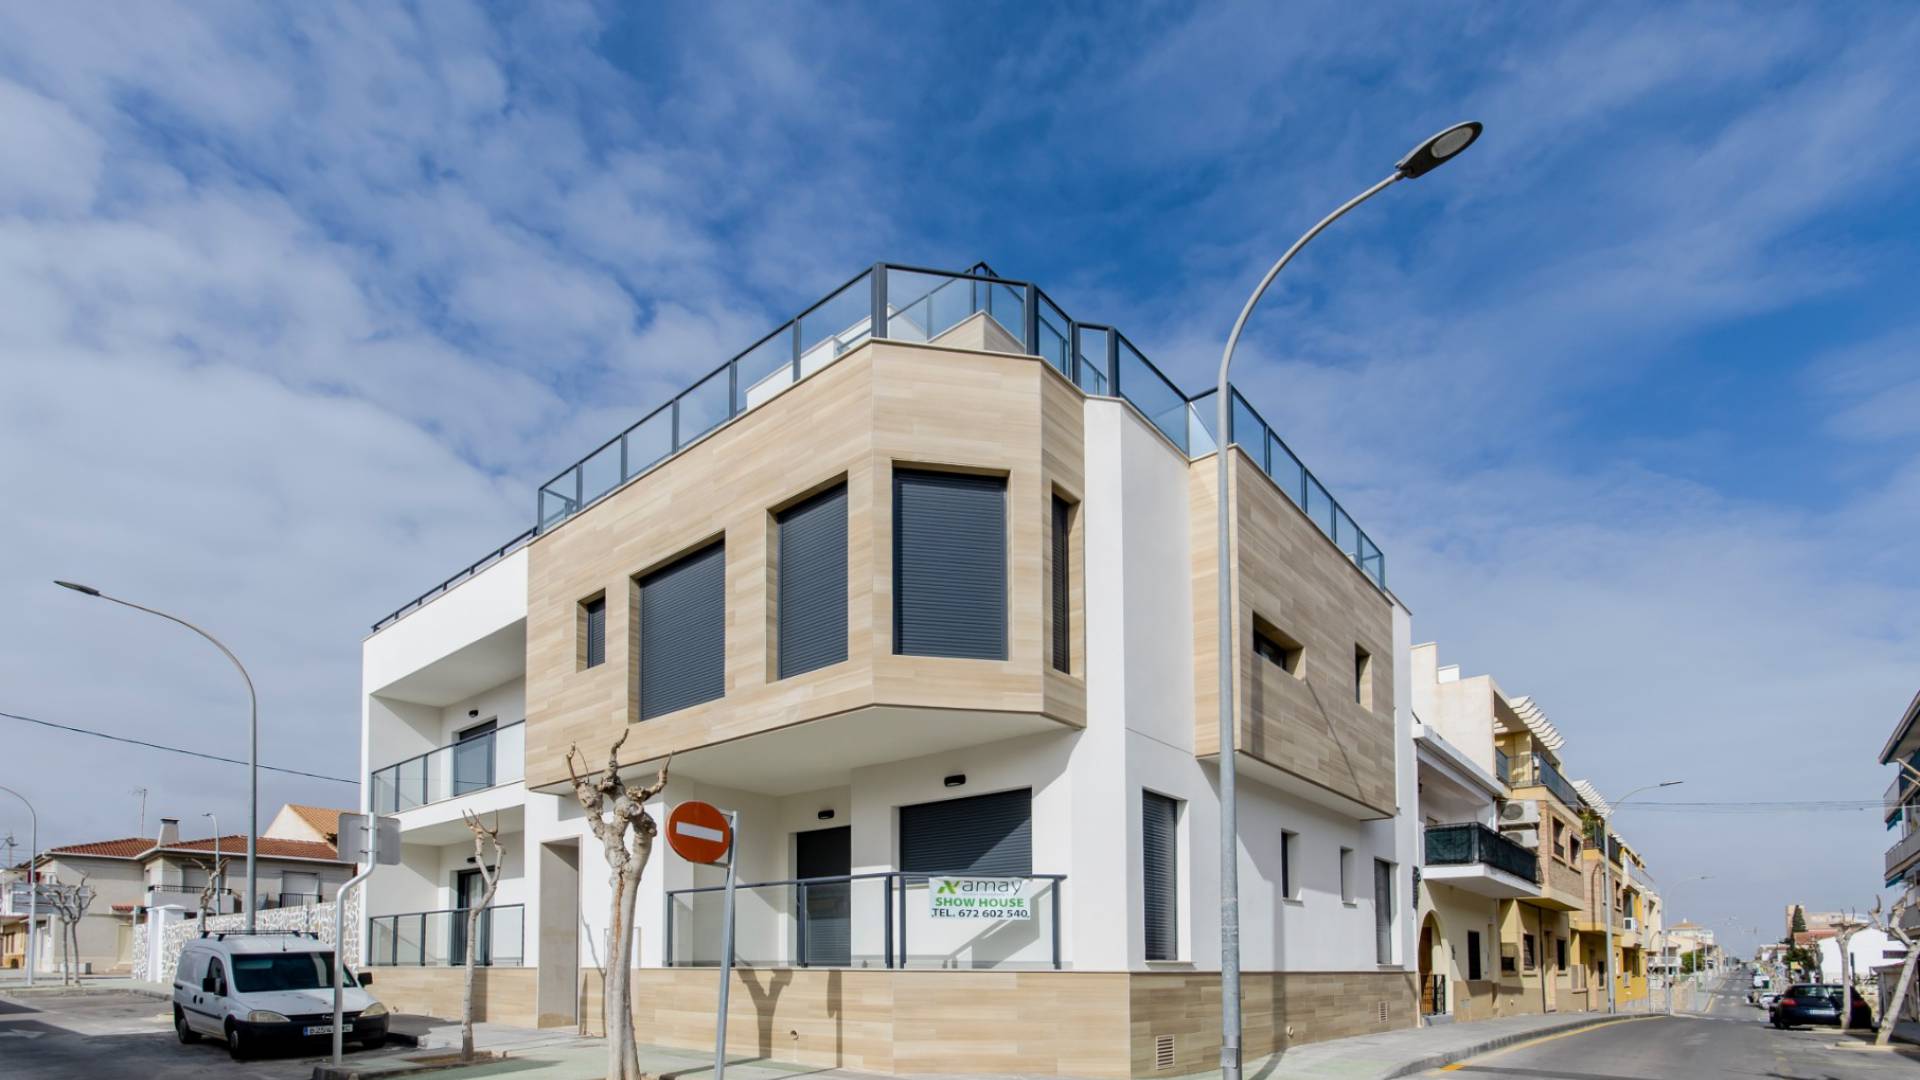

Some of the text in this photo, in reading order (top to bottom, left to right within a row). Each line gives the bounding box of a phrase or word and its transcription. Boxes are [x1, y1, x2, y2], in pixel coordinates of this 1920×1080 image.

[935, 897, 1024, 908] SHOW HOUSE
[932, 908, 955, 918] TEL.
[958, 909, 979, 918] 672
[982, 909, 1003, 918] 602
